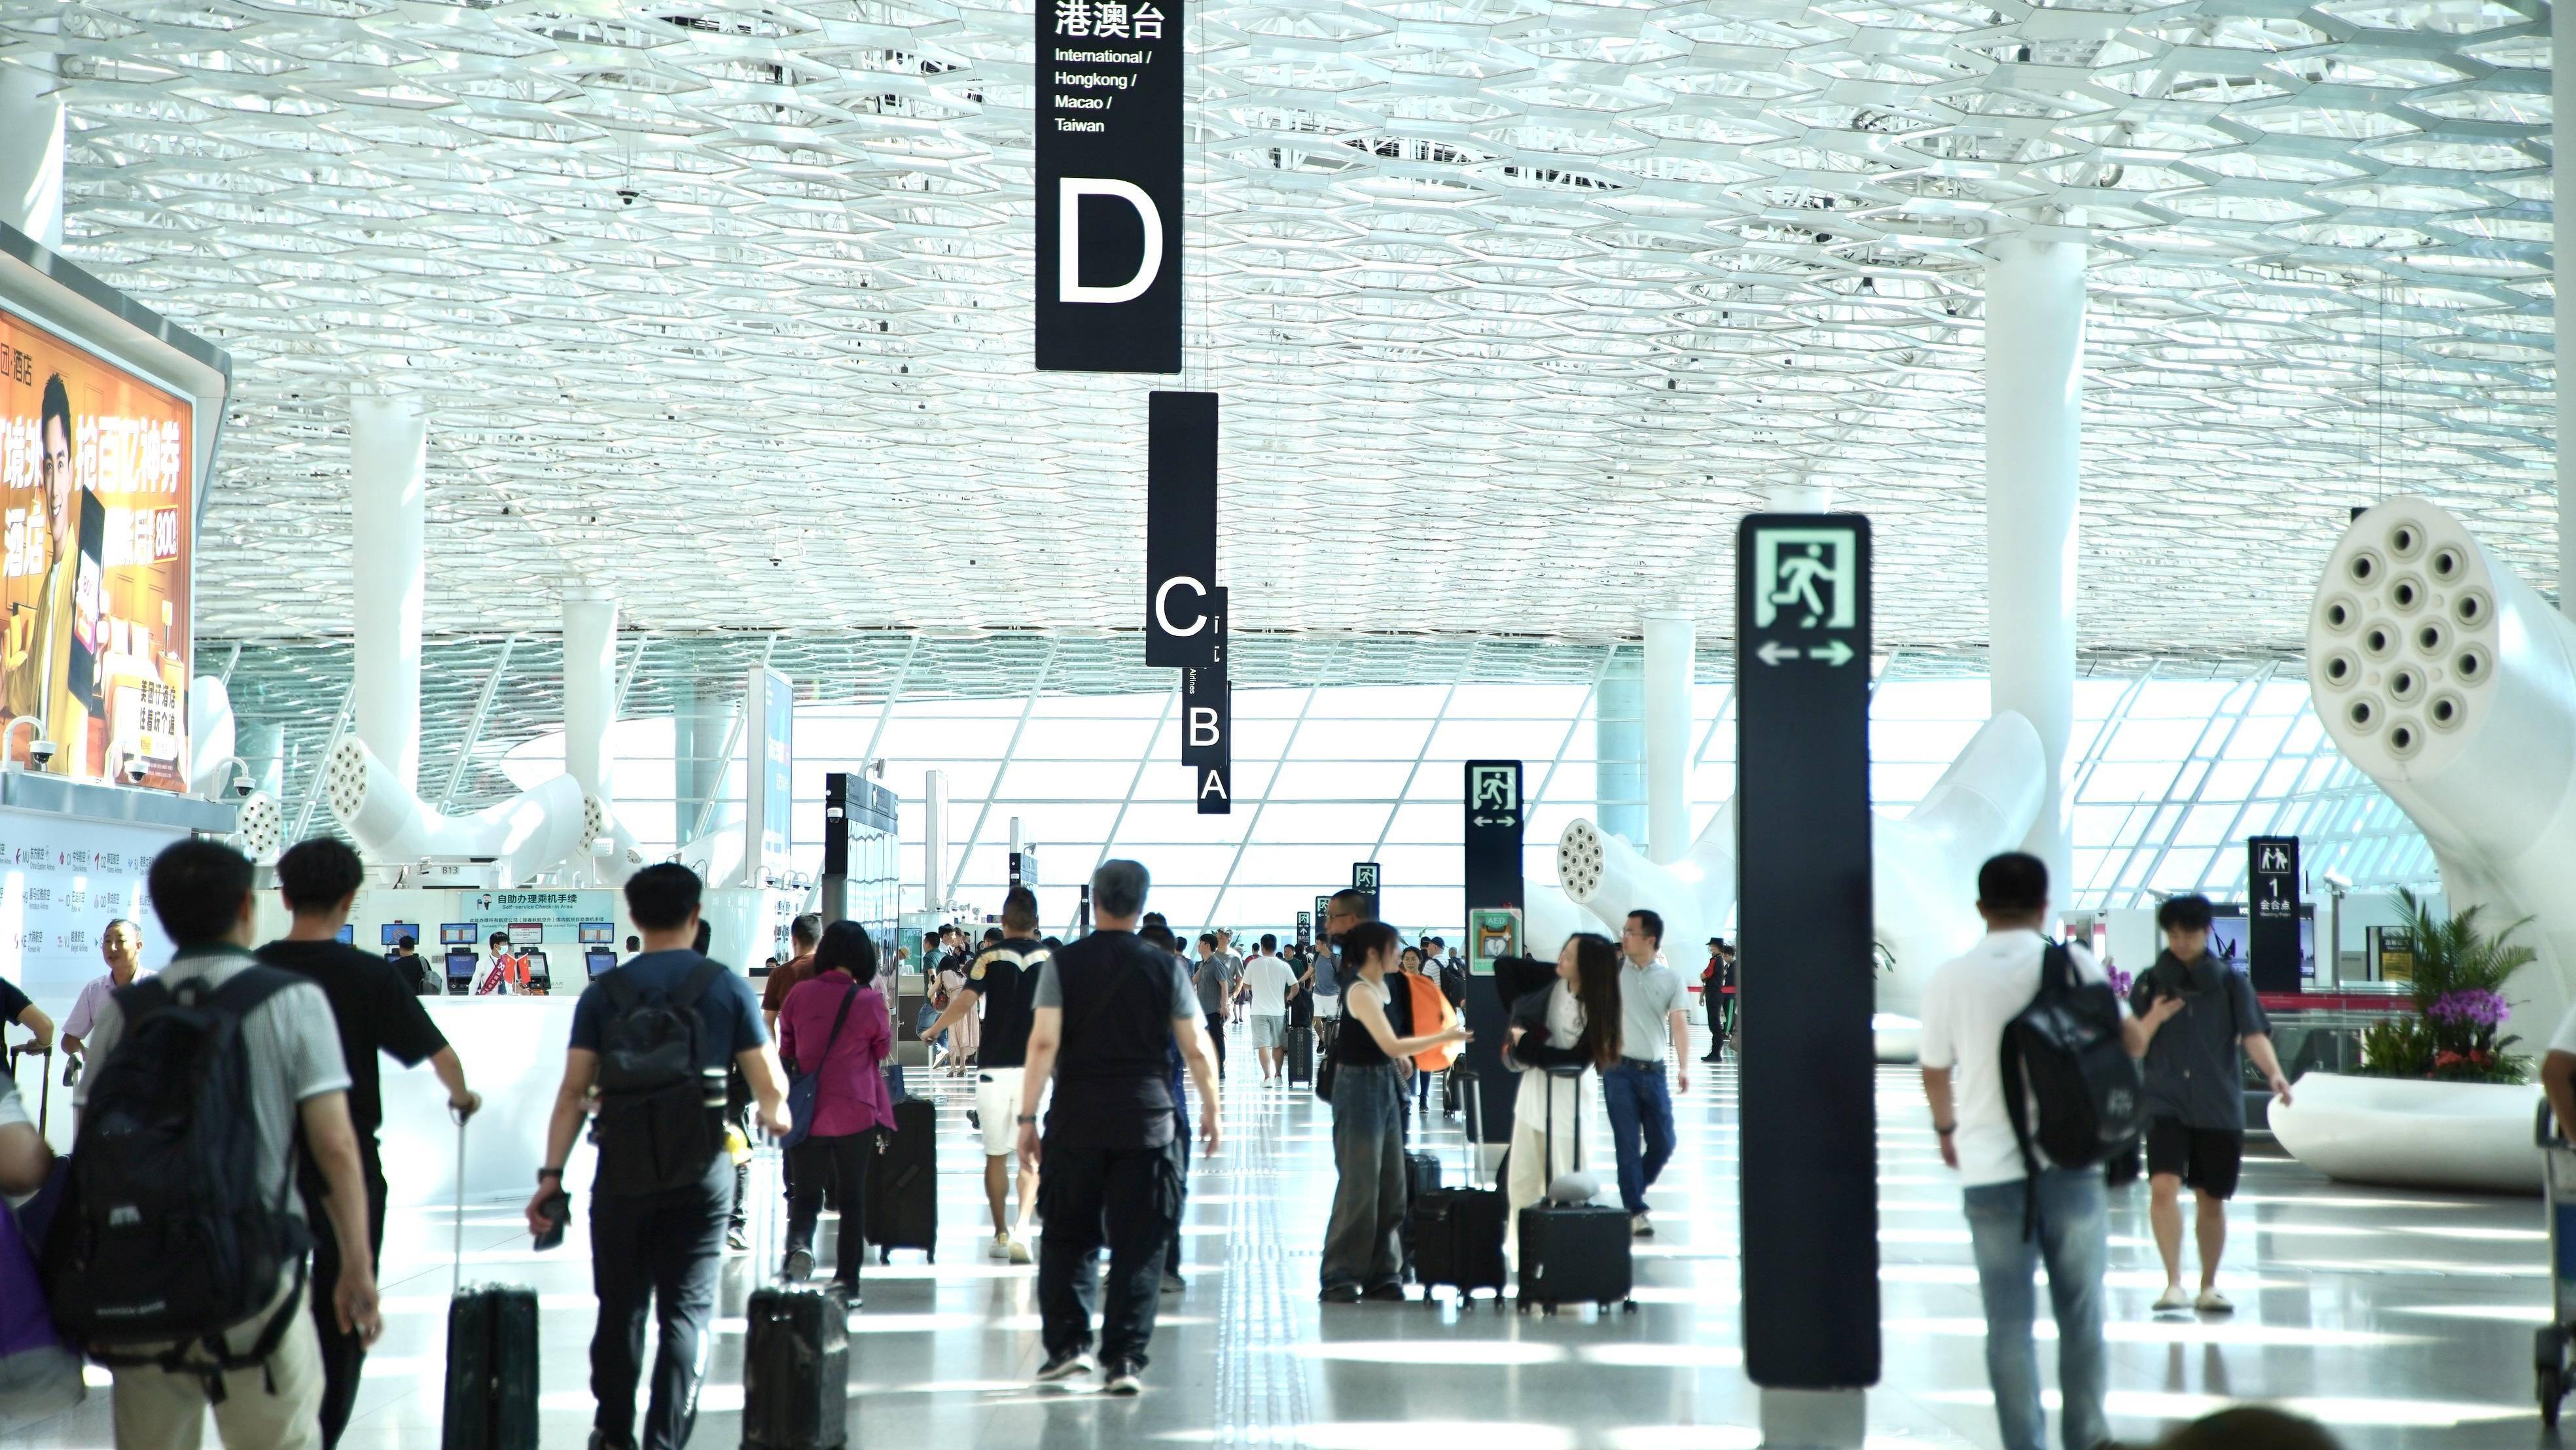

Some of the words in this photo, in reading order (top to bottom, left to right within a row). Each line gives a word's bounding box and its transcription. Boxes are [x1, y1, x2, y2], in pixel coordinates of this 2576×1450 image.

[1054, 0, 1166, 39] 港澳台
[1055, 48, 1143, 63] International
[1055, 71, 1128, 90] Hongkong
[1055, 94, 1103, 109] Macao
[1054, 118, 1105, 132] Taiwan
[1059, 177, 1163, 304] D
[1155, 576, 1208, 637] C
[1189, 667, 1197, 694] Airlines
[1190, 707, 1220, 747] B
[1200, 768, 1228, 800] A
[2269, 878, 2278, 897] 1
[497, 893, 578, 905] 自助办理乘机手续
[2259, 899, 2291, 911] 会合点
